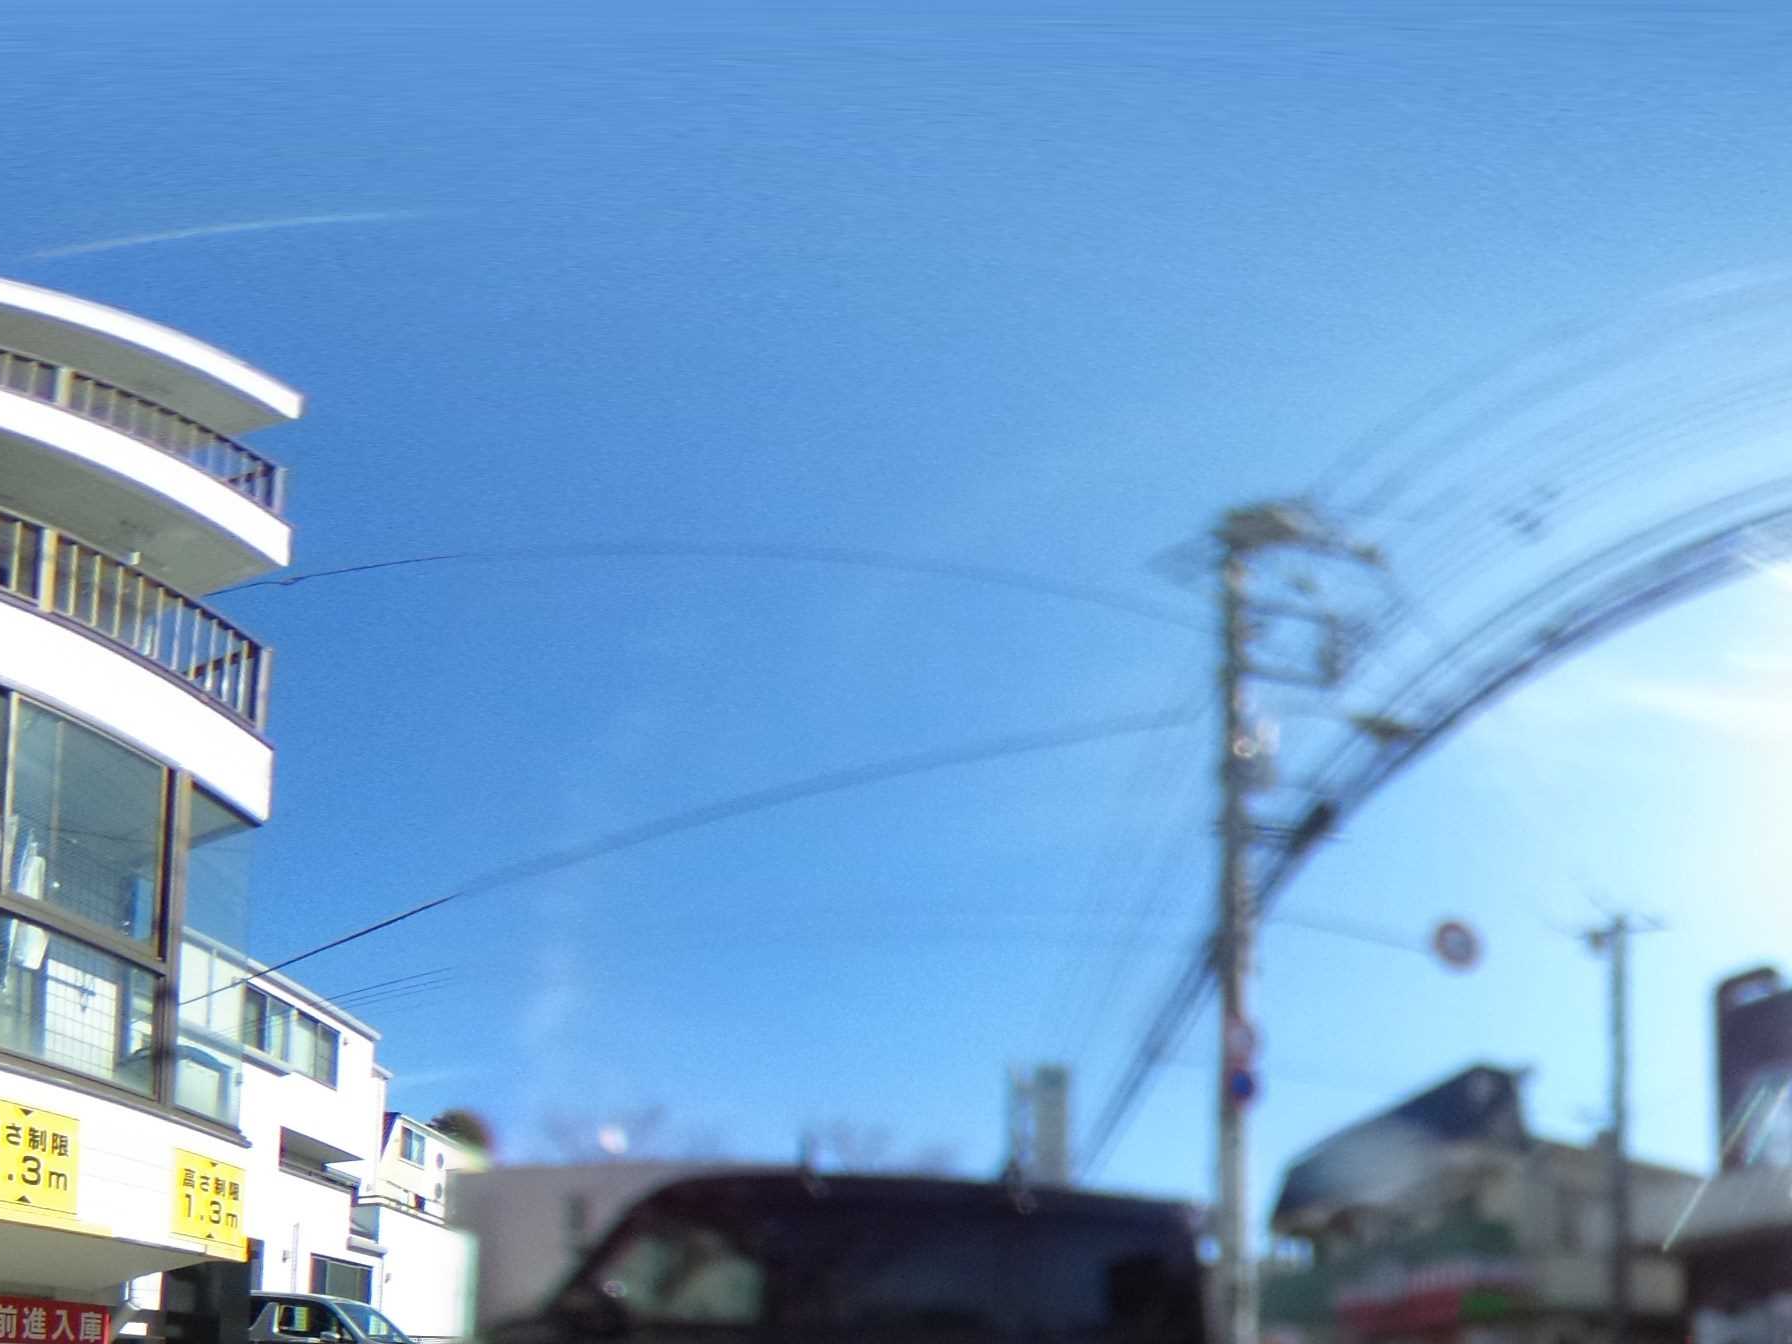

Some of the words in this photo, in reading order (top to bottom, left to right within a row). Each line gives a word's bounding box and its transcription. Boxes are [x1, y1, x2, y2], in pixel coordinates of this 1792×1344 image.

[182, 1168, 239, 1201] 高さ制限
[184, 1194, 237, 1228] 1.3m
